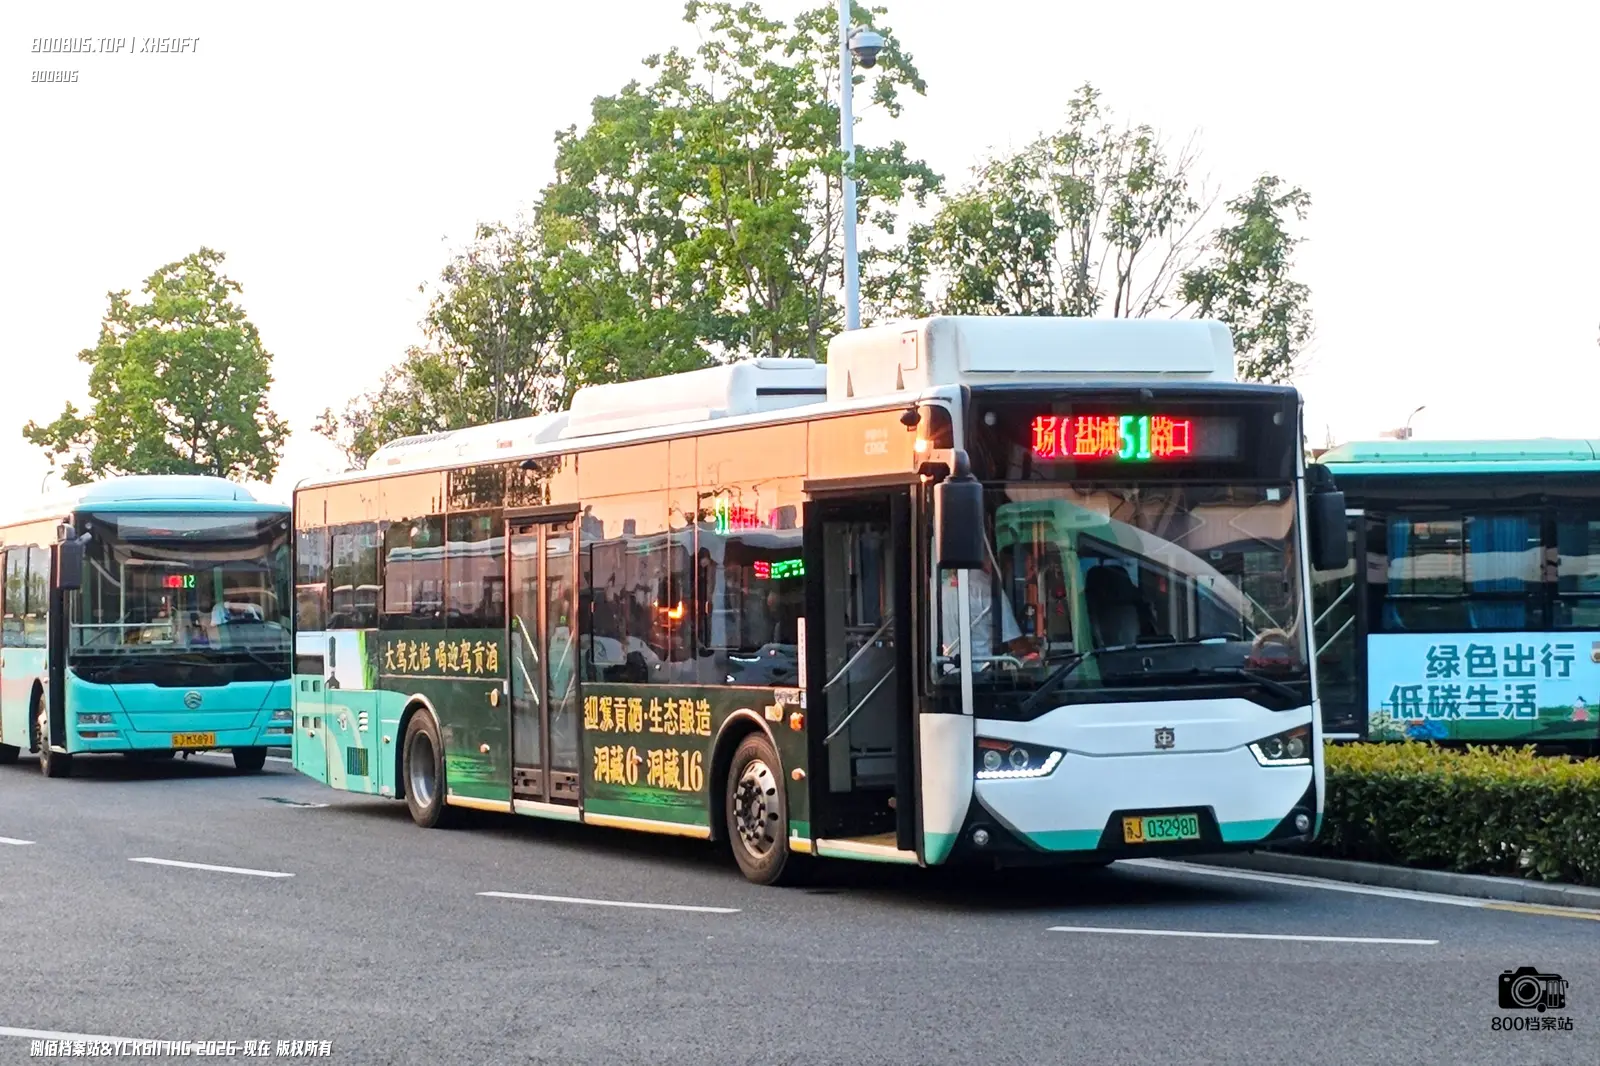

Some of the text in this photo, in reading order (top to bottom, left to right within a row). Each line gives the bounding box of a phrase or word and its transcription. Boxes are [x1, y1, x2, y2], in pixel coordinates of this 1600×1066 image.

[385, 640, 431, 673] 大驾光临
[1425, 643, 1576, 679] 绿色出行
[1387, 683, 1538, 720] 低碳生活
[594, 745, 704, 792] 洞藏6 洞藏16
